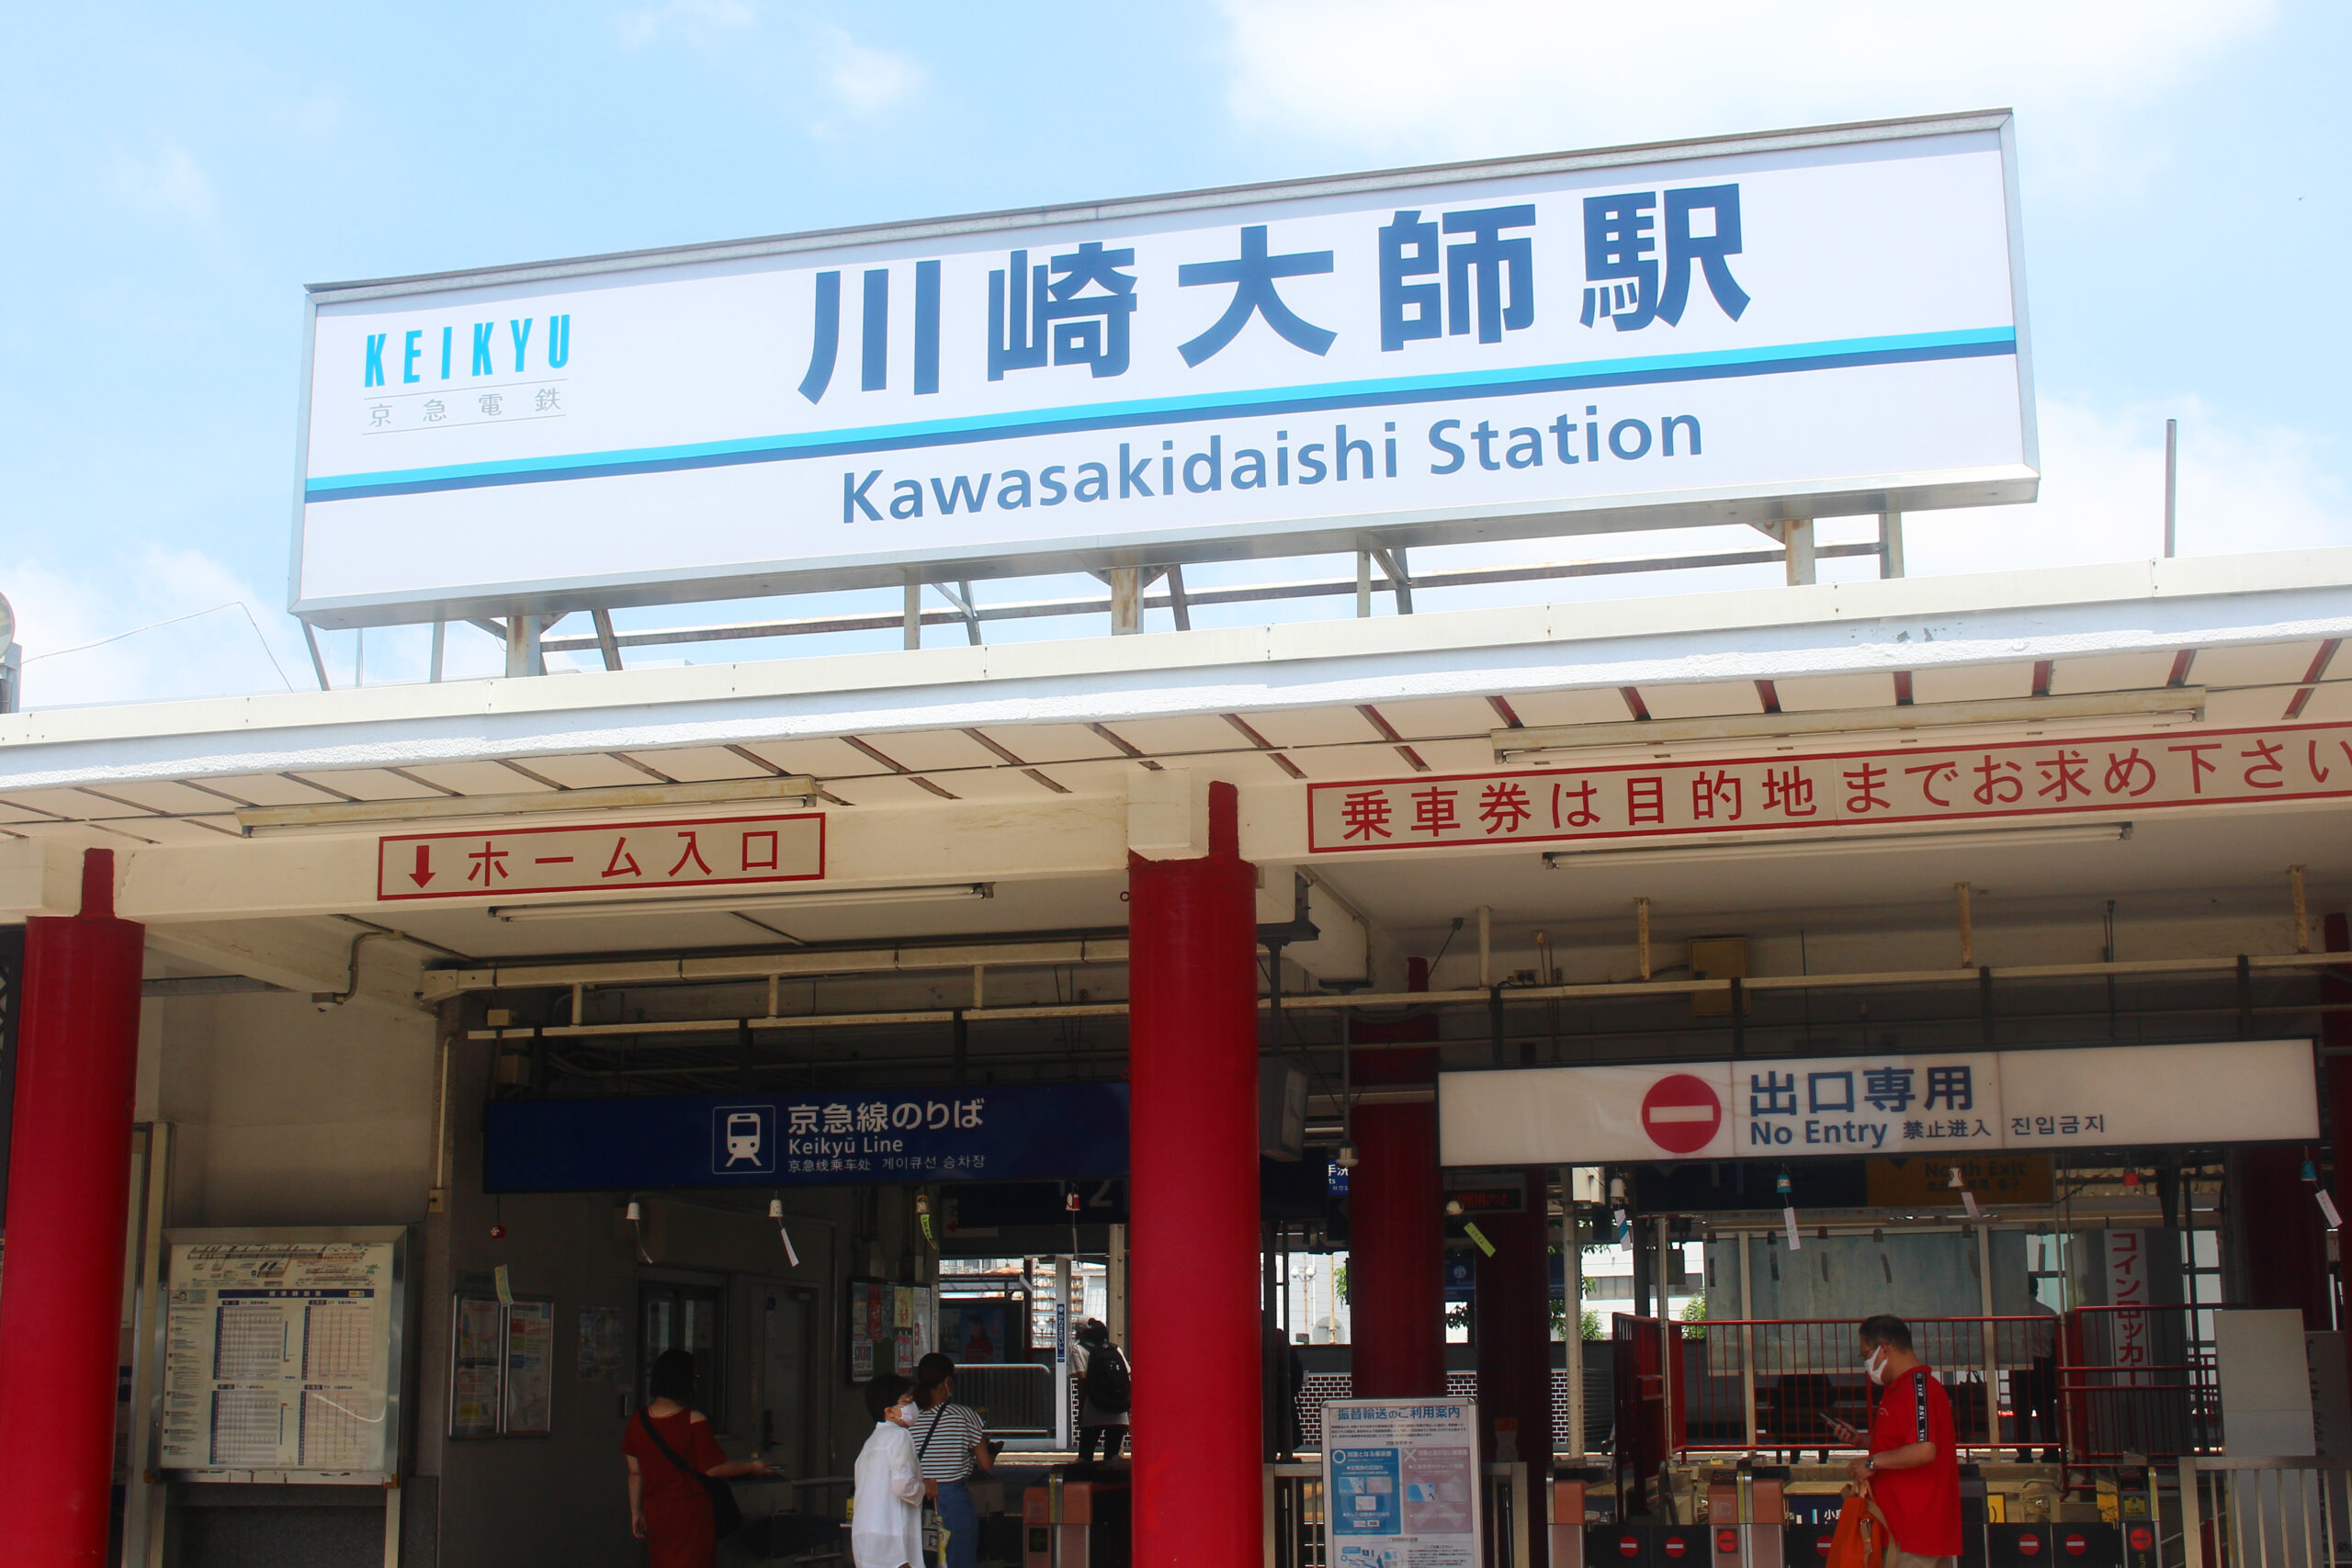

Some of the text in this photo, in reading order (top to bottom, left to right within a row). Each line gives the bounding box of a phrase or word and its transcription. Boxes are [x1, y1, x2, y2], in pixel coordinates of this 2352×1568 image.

[797, 183, 1751, 406] 川崎大師駅
[364, 314, 571, 388] KEIKYU
[368, 388, 561, 428] 京急電鉄
[842, 403, 1703, 525] Kawasakidaishi Station
[1340, 739, 2352, 841] 乗車券は目的地までお求め下さい
[468, 829, 778, 887] ホーム入口
[1750, 1066, 1973, 1117] 出口専用
[787, 1098, 986, 1135] 京急線のりば
[1750, 1119, 1888, 1148] No Entry
[1903, 1119, 1992, 1140] 禁止进入
[2010, 1114, 2106, 1136] 진입금지
[788, 1136, 903, 1158] Keikyū Line
[882, 1155, 986, 1170] 게이큐선 승차장
[2112, 1233, 2144, 1385] コインロッカー
[1338, 1405, 1461, 1420] 振替輸送のご利用案内
